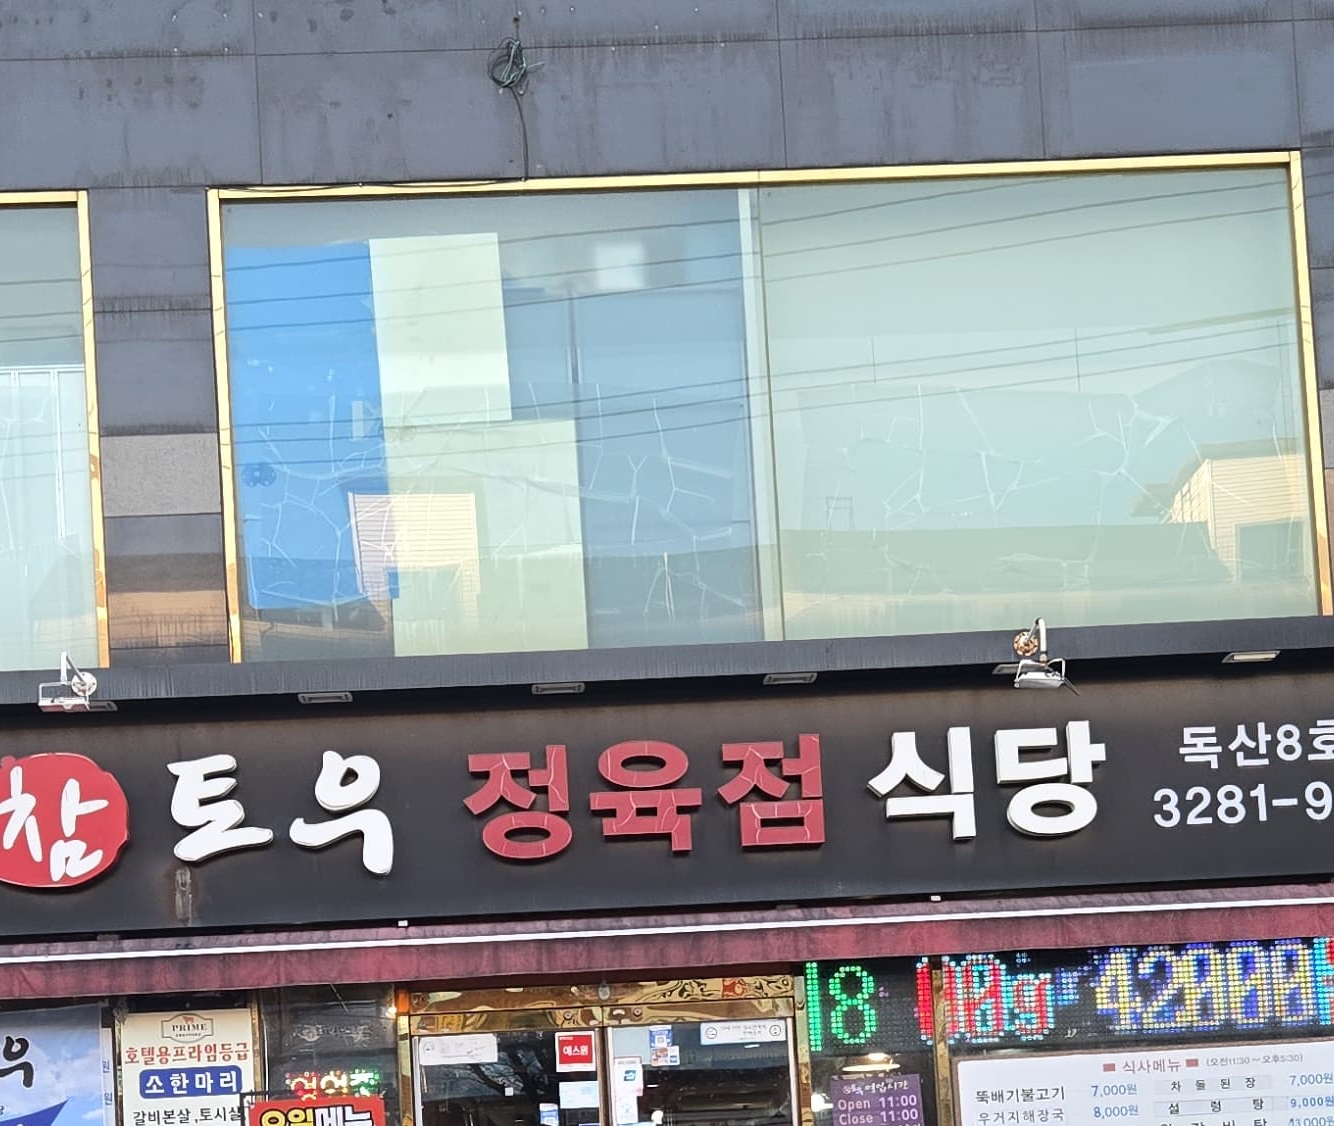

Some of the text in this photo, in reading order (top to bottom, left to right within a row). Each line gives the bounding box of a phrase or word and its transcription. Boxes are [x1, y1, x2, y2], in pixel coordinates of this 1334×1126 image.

[463, 732, 825, 861] 정육점
[866, 719, 1107, 842] 식당
[172, 1023, 207, 1032] PRIME
[125, 1042, 249, 1065] 호텔용프라임등급
[1123, 1058, 1182, 1074] 식사메뉴
[145, 1071, 237, 1095] 소한마리
[1289, 1073, 1334, 1086] 7,000원
[976, 1084, 1138, 1104] 뚝배기불고기 7,000원
[1290, 1096, 1334, 1108] 9,000원
[838, 1095, 917, 1113] Open 11:00
[839, 1108, 919, 1126] Close 11:00
[978, 1105, 1139, 1126] 우거지해장국 8,000원
